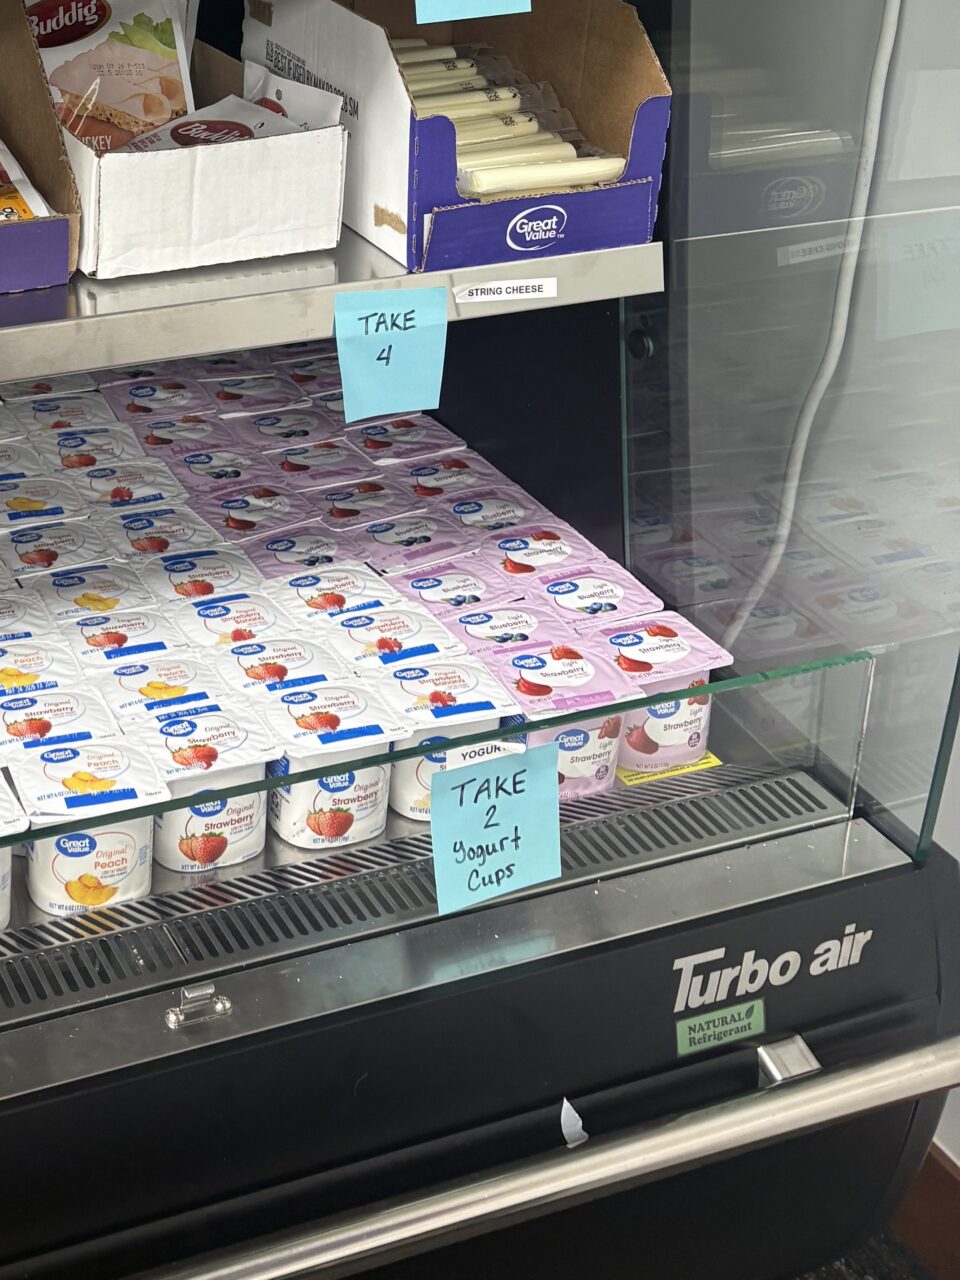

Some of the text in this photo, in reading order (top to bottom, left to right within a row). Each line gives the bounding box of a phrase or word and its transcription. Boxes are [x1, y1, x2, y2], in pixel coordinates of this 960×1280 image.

[30, 0, 99, 38] Buddig
[515, 215, 558, 235] Great
[524, 229, 556, 241] Value
[467, 284, 544, 297] STRING CHEESE
[357, 309, 417, 336] TAKE
[376, 344, 392, 366] 4
[577, 588, 614, 601] Blueberry
[540, 667, 585, 678] Strawberry
[309, 699, 355, 711] Strawberry
[25, 706, 74, 718] Strawberry
[664, 718, 702, 732] Strawberry
[558, 733, 585, 744] Great
[564, 740, 583, 748] Value
[570, 751, 612, 764] Strawberry
[451, 769, 527, 807] TAKE
[483, 804, 500, 829] 2
[60, 836, 90, 848] Great
[67, 844, 91, 853] Value
[95, 845, 128, 858] Original
[94, 857, 128, 871] Peach
[468, 864, 516, 892] Cups
[672, 923, 874, 1014] Turbo air
[687, 1012, 744, 1036] NATURAL
[688, 1021, 752, 1048] Refrigerant
